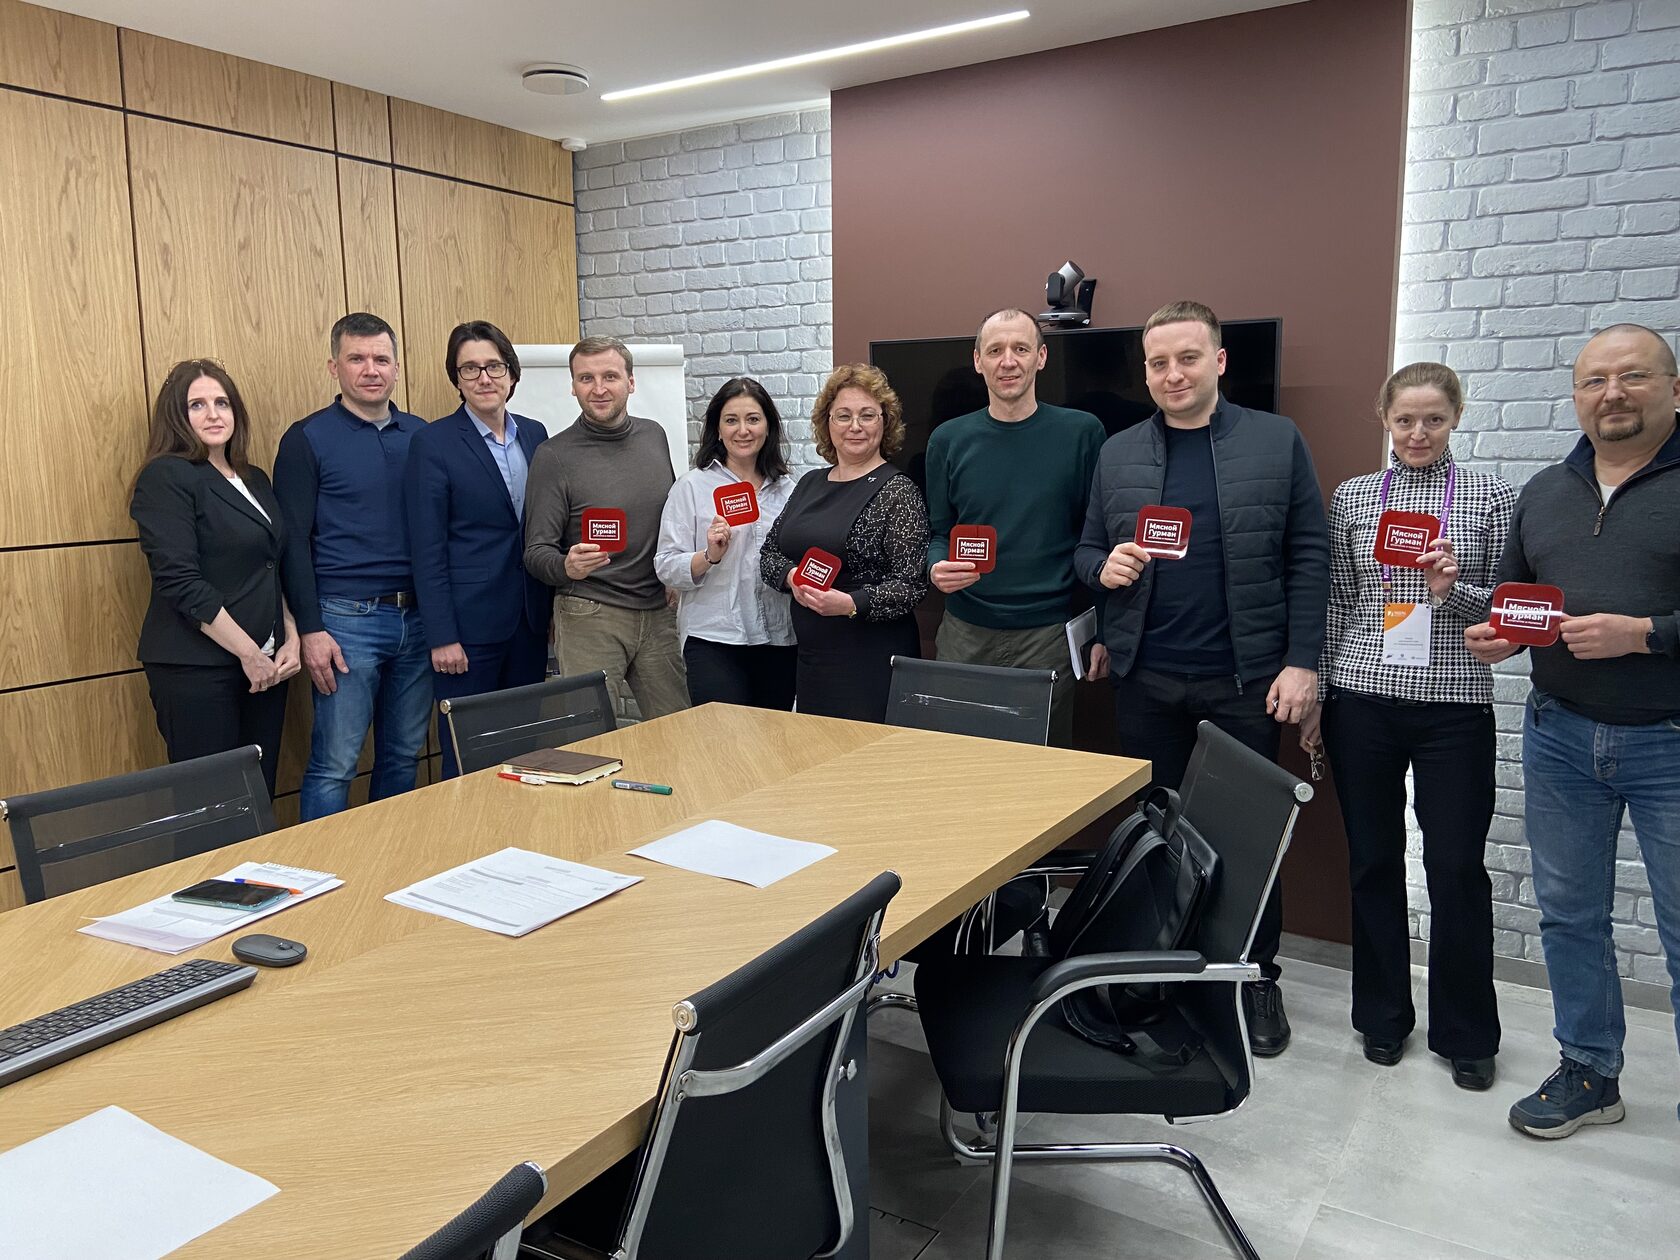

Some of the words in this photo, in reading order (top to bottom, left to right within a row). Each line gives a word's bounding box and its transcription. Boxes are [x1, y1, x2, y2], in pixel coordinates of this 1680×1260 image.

[1150, 523, 1177, 531] Мясной
[1148, 529, 1177, 538] Гурман
[1392, 529, 1423, 540] Мясной
[1390, 536, 1422, 546] Гурман
[1508, 603, 1545, 612] Мясной
